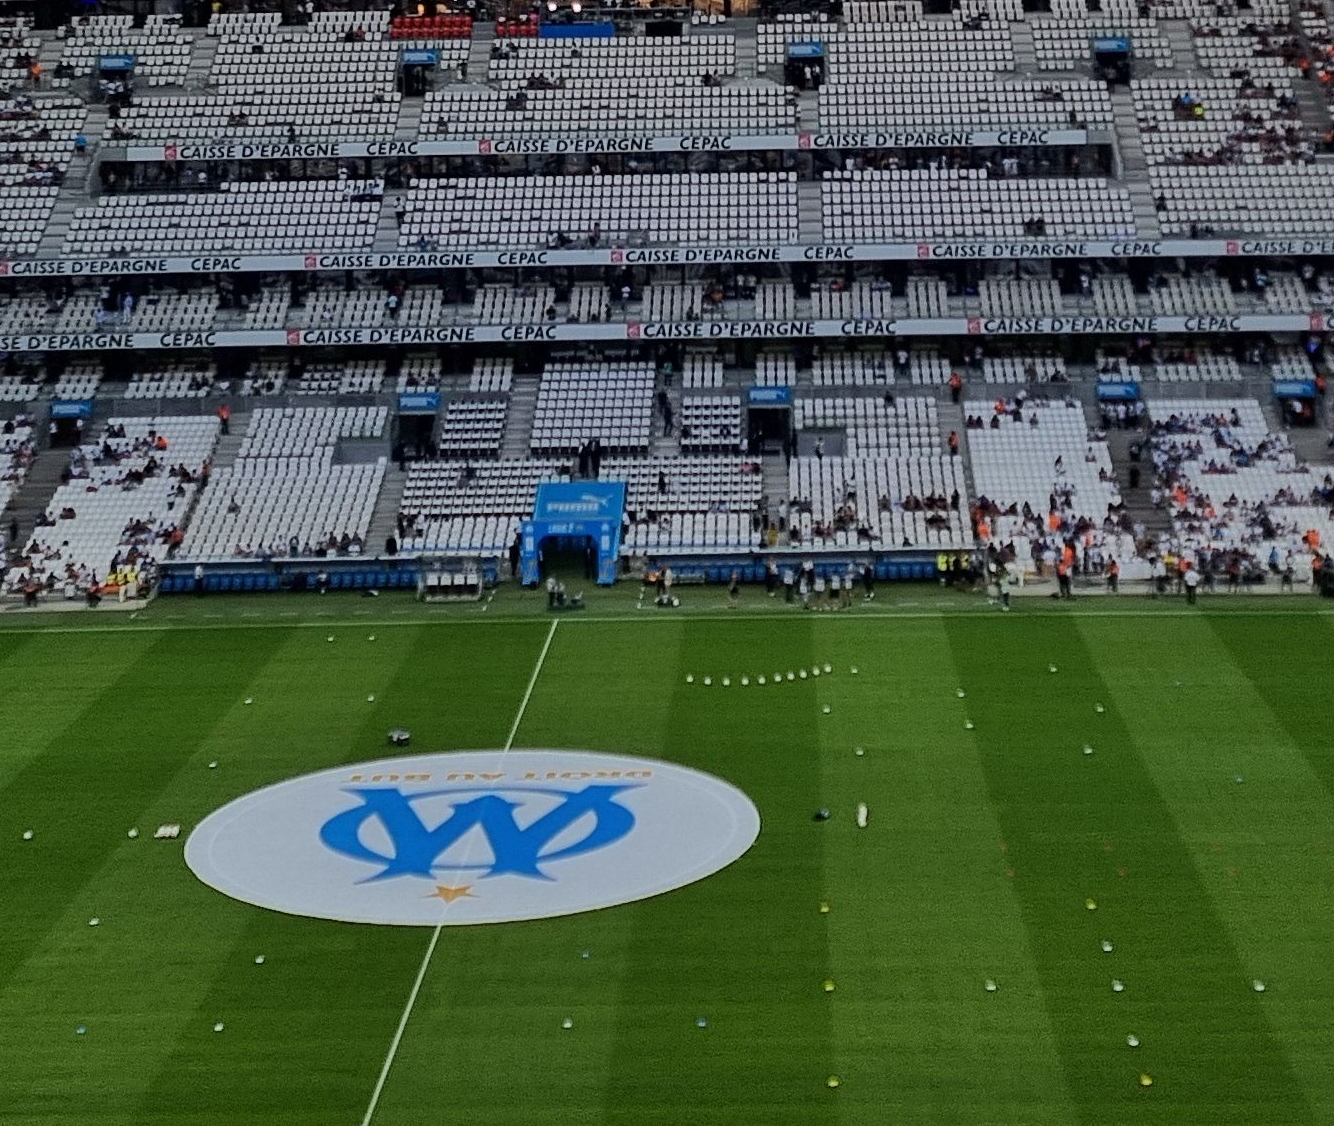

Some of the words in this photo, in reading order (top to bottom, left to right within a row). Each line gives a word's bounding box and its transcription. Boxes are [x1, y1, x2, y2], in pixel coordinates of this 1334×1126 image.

[494, 140, 549, 153] CAISSE
[556, 138, 654, 152] D'EPARGNE
[679, 137, 732, 150] CEPAC
[813, 135, 868, 148] CAISSE
[875, 132, 974, 146] D'EPARGNE
[997, 132, 1050, 145] CEPAC
[180, 146, 236, 159] CAISSE
[242, 144, 339, 158] D'EPARGNE
[367, 142, 417, 155] CEPAC
[625, 250, 679, 262] CAISSE
[685, 249, 780, 261] D'EPARGNE
[804, 246, 854, 259] CEPAC
[932, 245, 986, 257] CAISSE
[992, 243, 1088, 257] D'EPARGNE
[1111, 242, 1162, 255] CEPAC
[1242, 241, 1295, 253] CAISSE
[12, 262, 67, 274] CAISSE
[71, 260, 167, 273] D'EPARGNE
[191, 258, 241, 270] CEPAC
[320, 255, 372, 268] CAISSE
[379, 254, 474, 267] D'EPARGNE
[498, 252, 548, 264] CEPAC
[643, 323, 703, 336] CAISSE
[709, 322, 815, 335] D'EPARGNE
[841, 321, 897, 334] CEPAC
[984, 320, 1044, 332] CAISSE
[1050, 318, 1158, 332] D'EPARGNE
[1184, 318, 1241, 331] CEPAC
[27, 335, 134, 349] D'EPARGNE
[160, 334, 215, 347] CEPAC
[303, 332, 363, 344] CAISSE
[370, 328, 475, 342] D'EPARGNE
[501, 326, 556, 339] CEPAC
